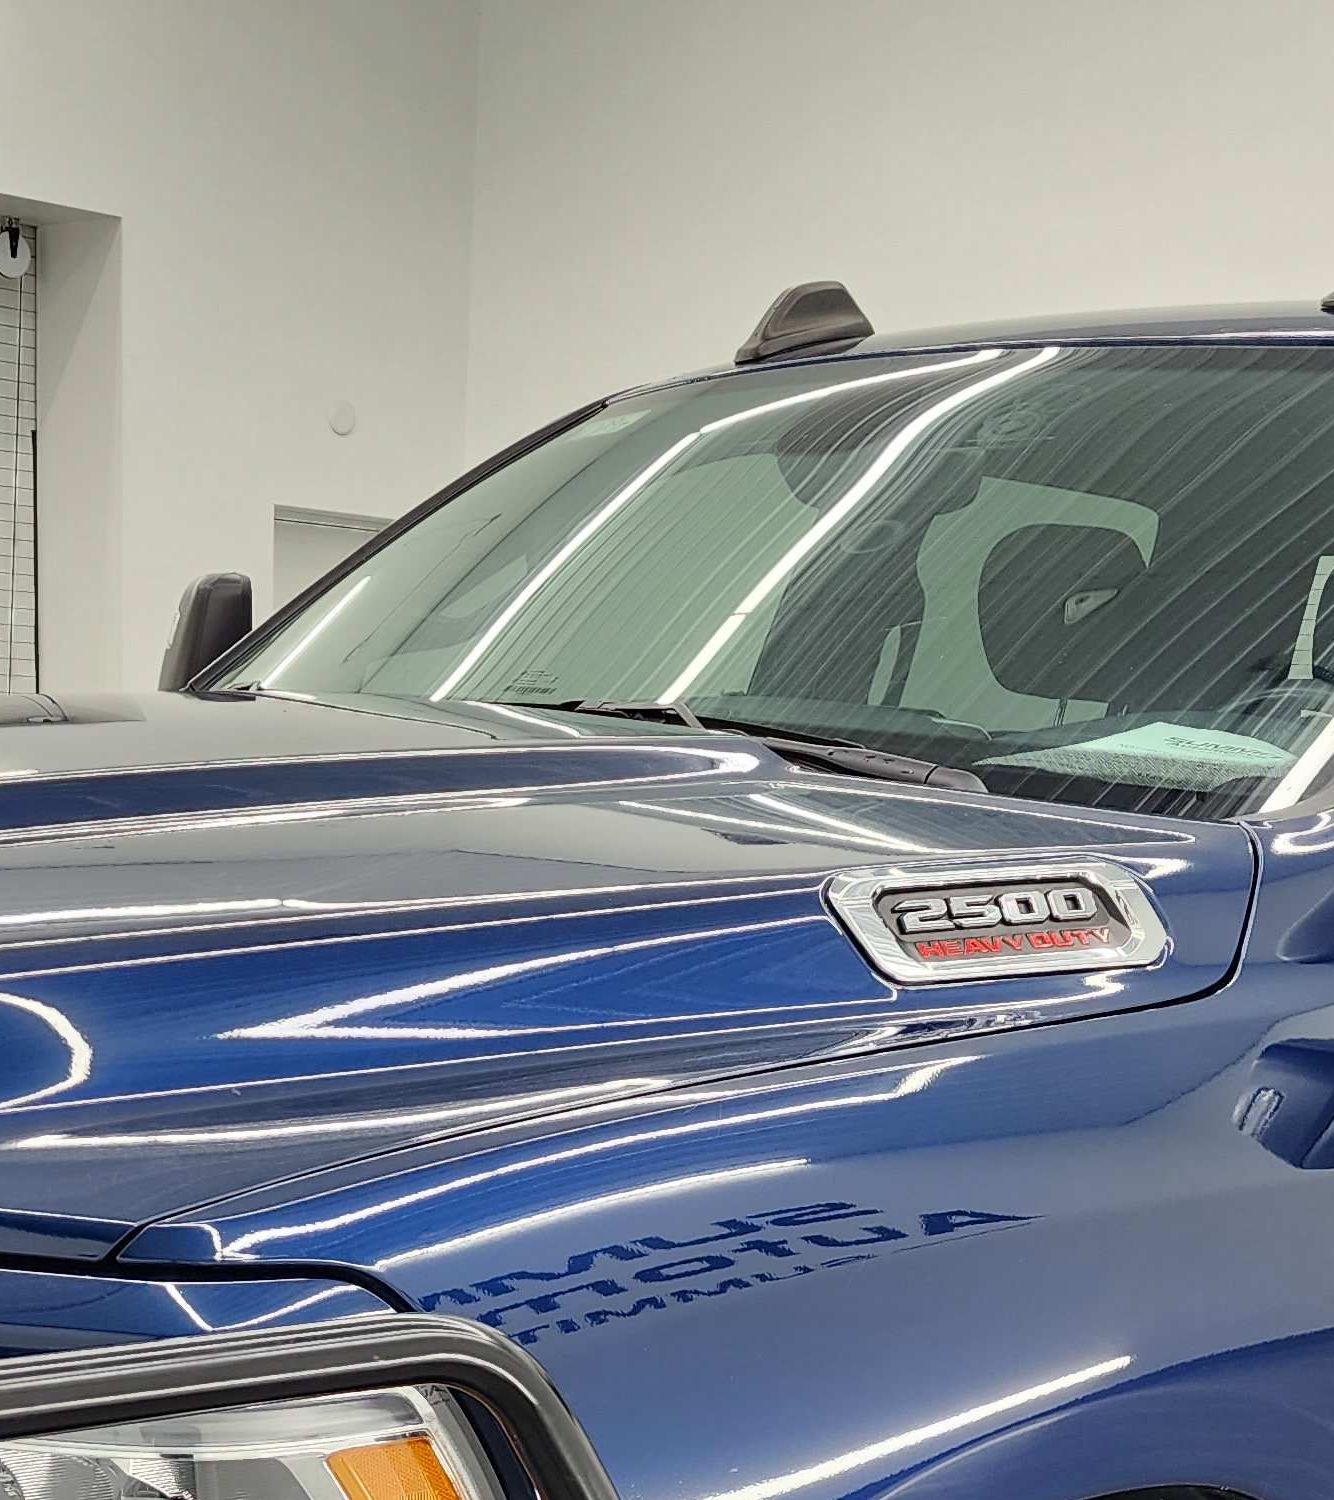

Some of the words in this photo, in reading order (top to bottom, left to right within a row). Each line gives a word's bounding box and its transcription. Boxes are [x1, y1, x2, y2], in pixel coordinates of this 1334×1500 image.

[892, 887, 1098, 935] 2500
[915, 933, 1025, 958] HEAVY
[1026, 927, 1111, 949] DUTY
